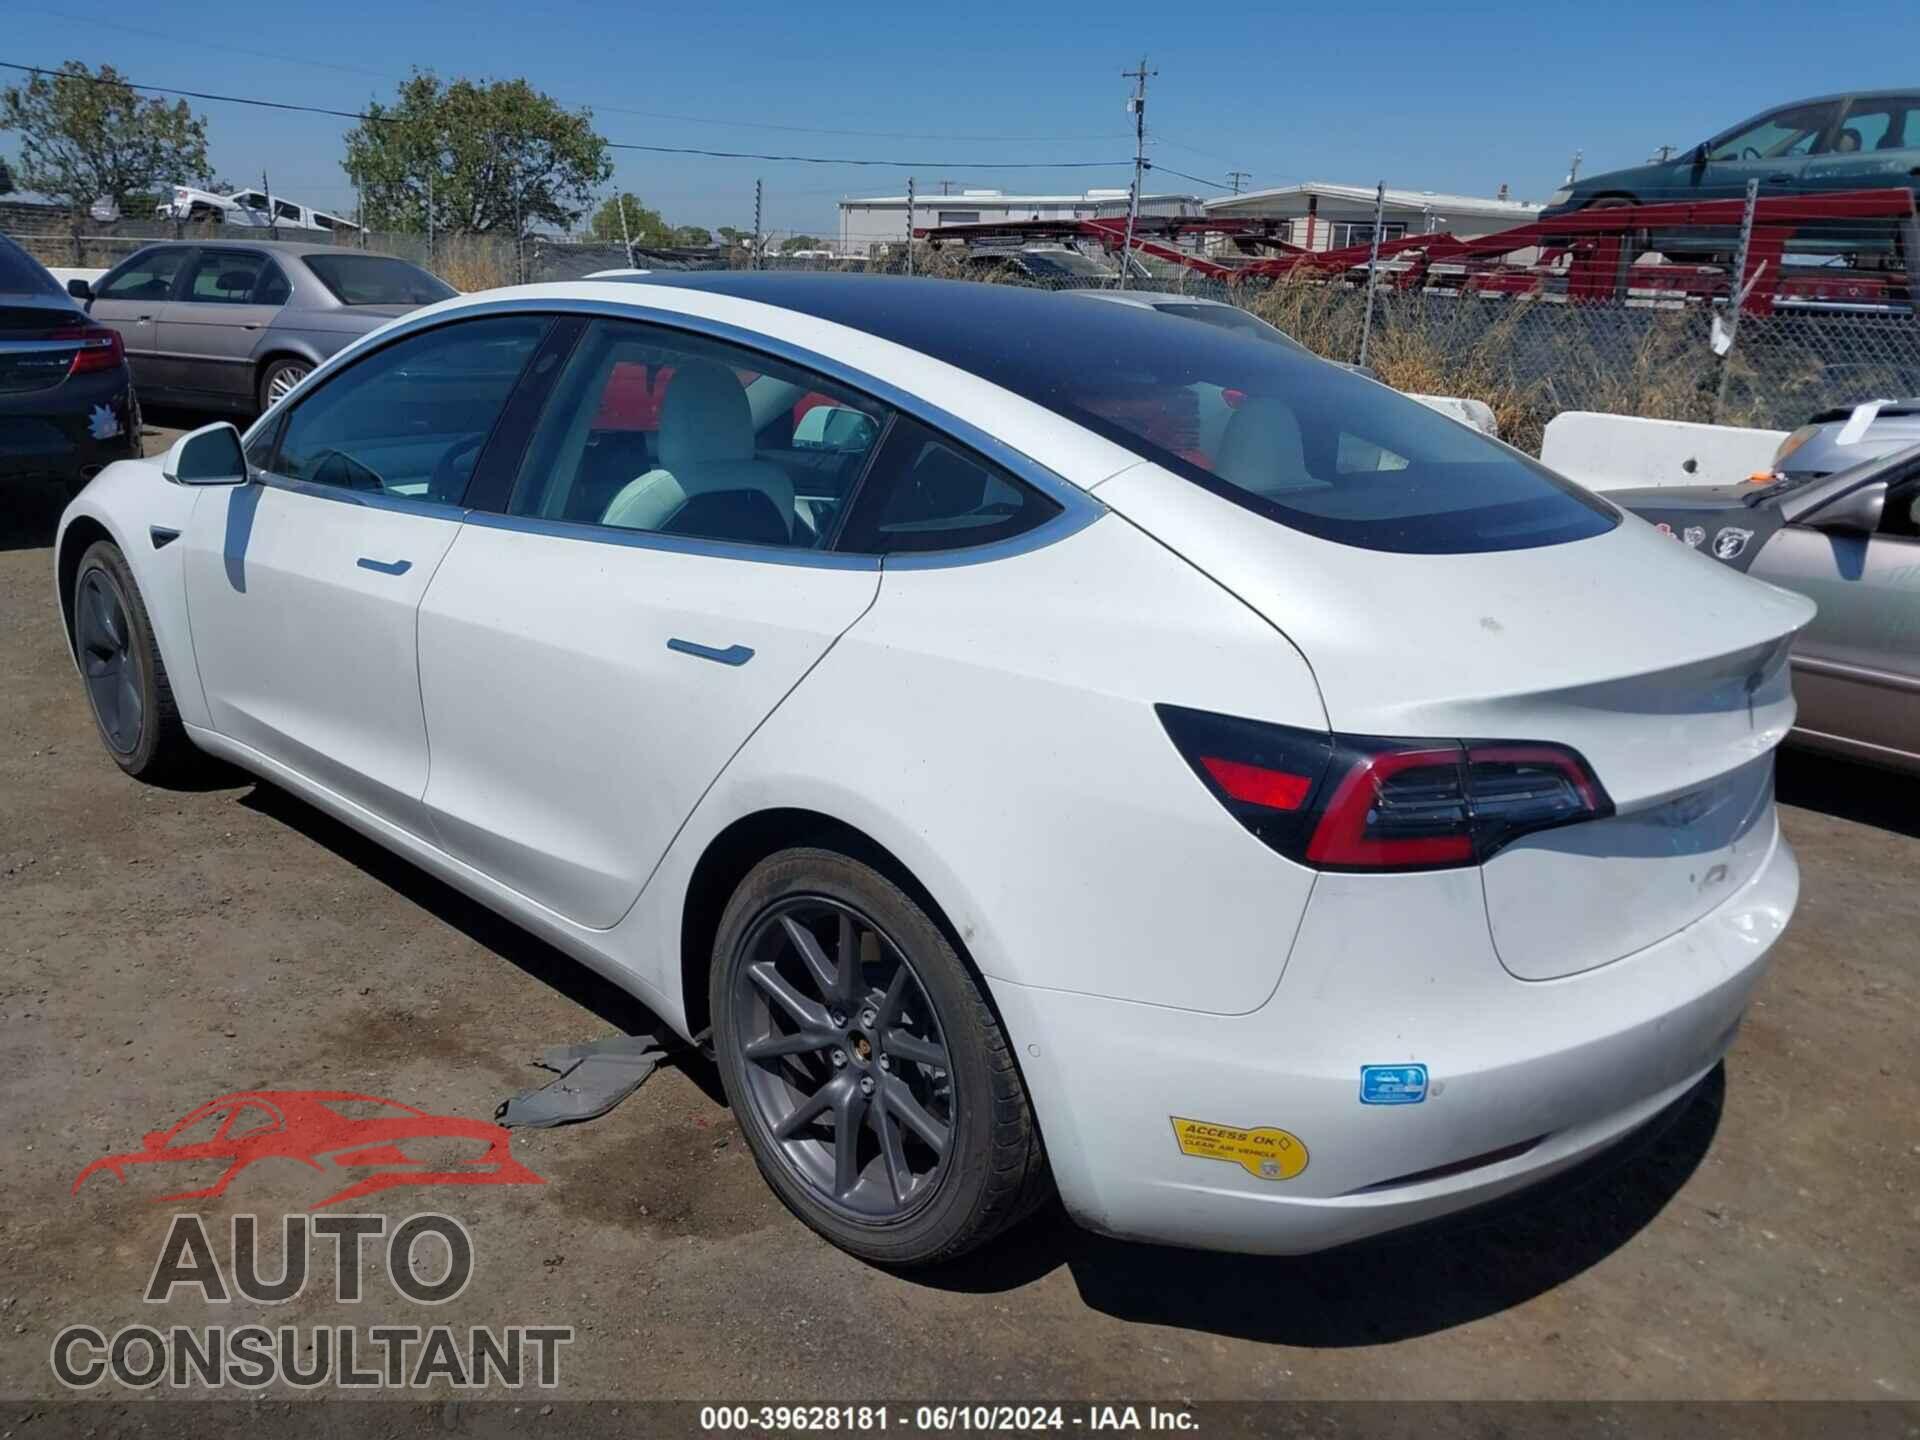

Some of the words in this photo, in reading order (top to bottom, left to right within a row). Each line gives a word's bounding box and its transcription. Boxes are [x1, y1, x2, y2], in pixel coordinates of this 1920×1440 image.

[1185, 1125, 1248, 1141] ACCESS
[1253, 1136, 1276, 1147] OK
[1184, 1139, 1215, 1149] CLEAN
[1219, 1144, 1234, 1152] AIR
[1238, 1148, 1276, 1158] VEHICLE
